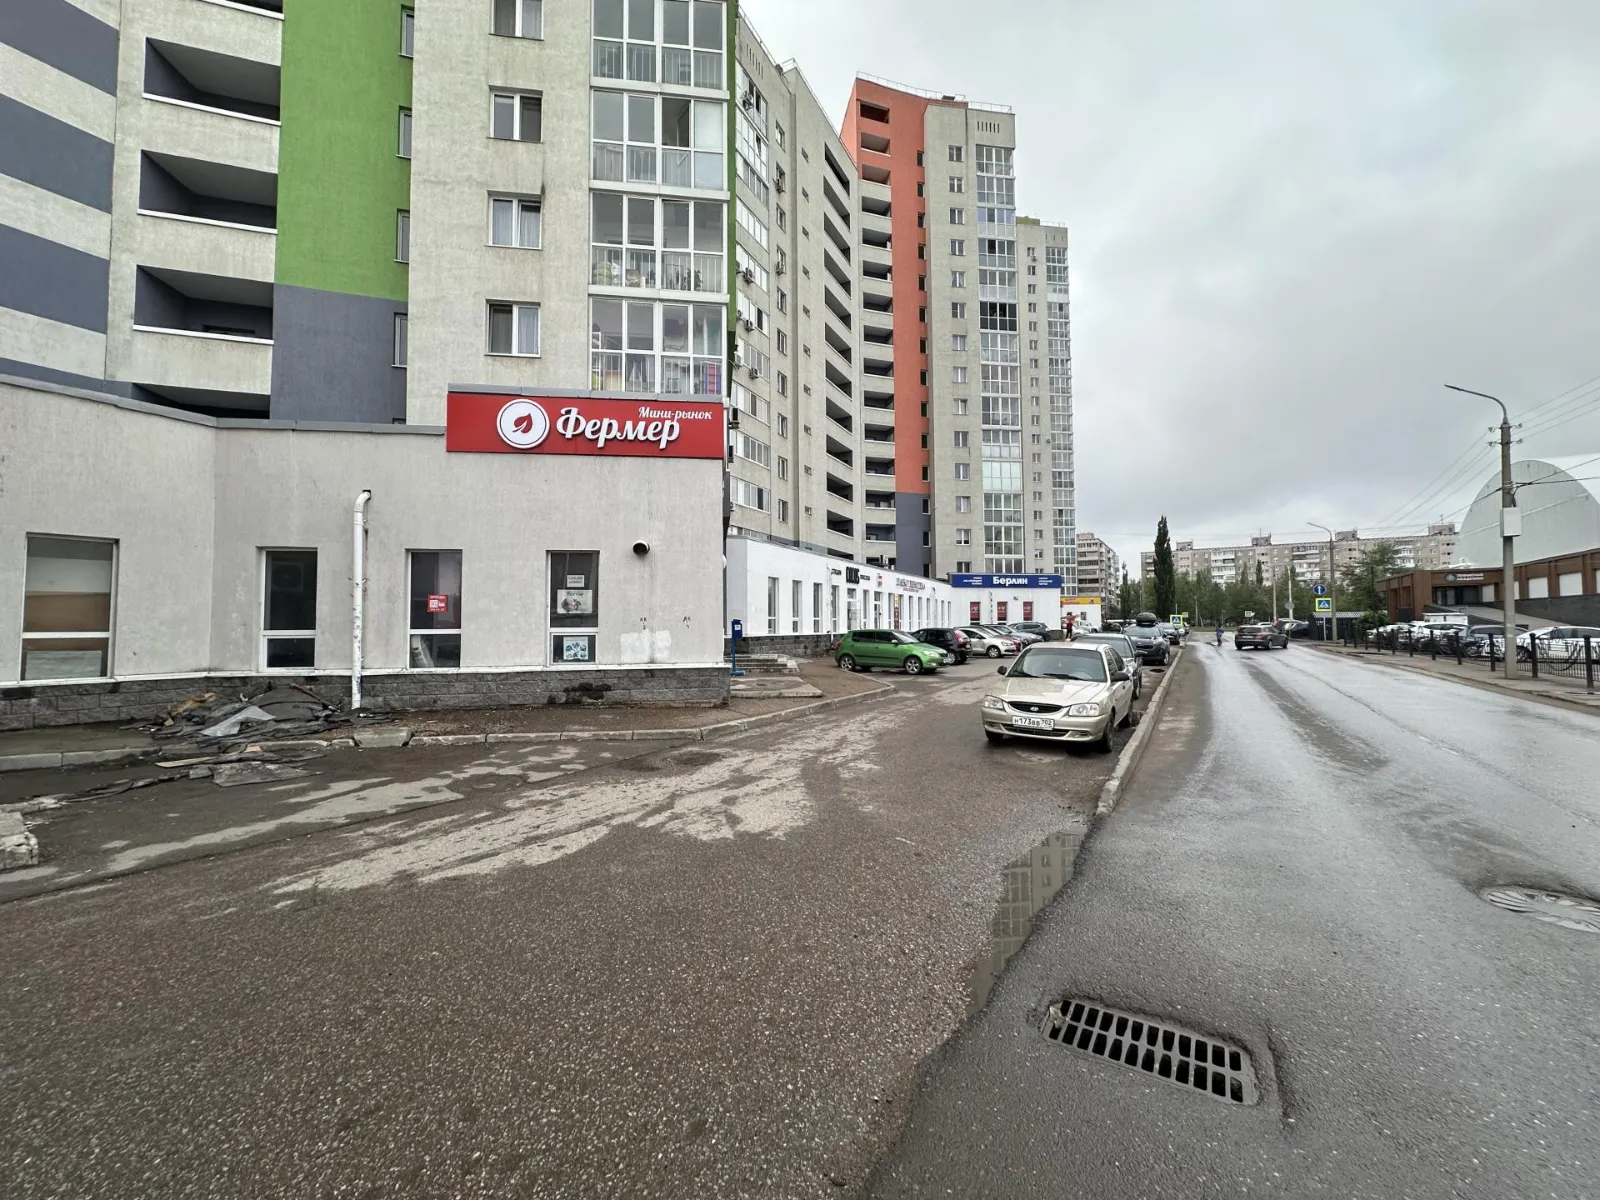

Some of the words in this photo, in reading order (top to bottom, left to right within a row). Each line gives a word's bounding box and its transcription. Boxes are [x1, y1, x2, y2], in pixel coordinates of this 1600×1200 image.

[638, 406, 713, 421] Мини-рынок
[556, 407, 680, 449] Фермер
[992, 576, 1028, 586] Берлин
